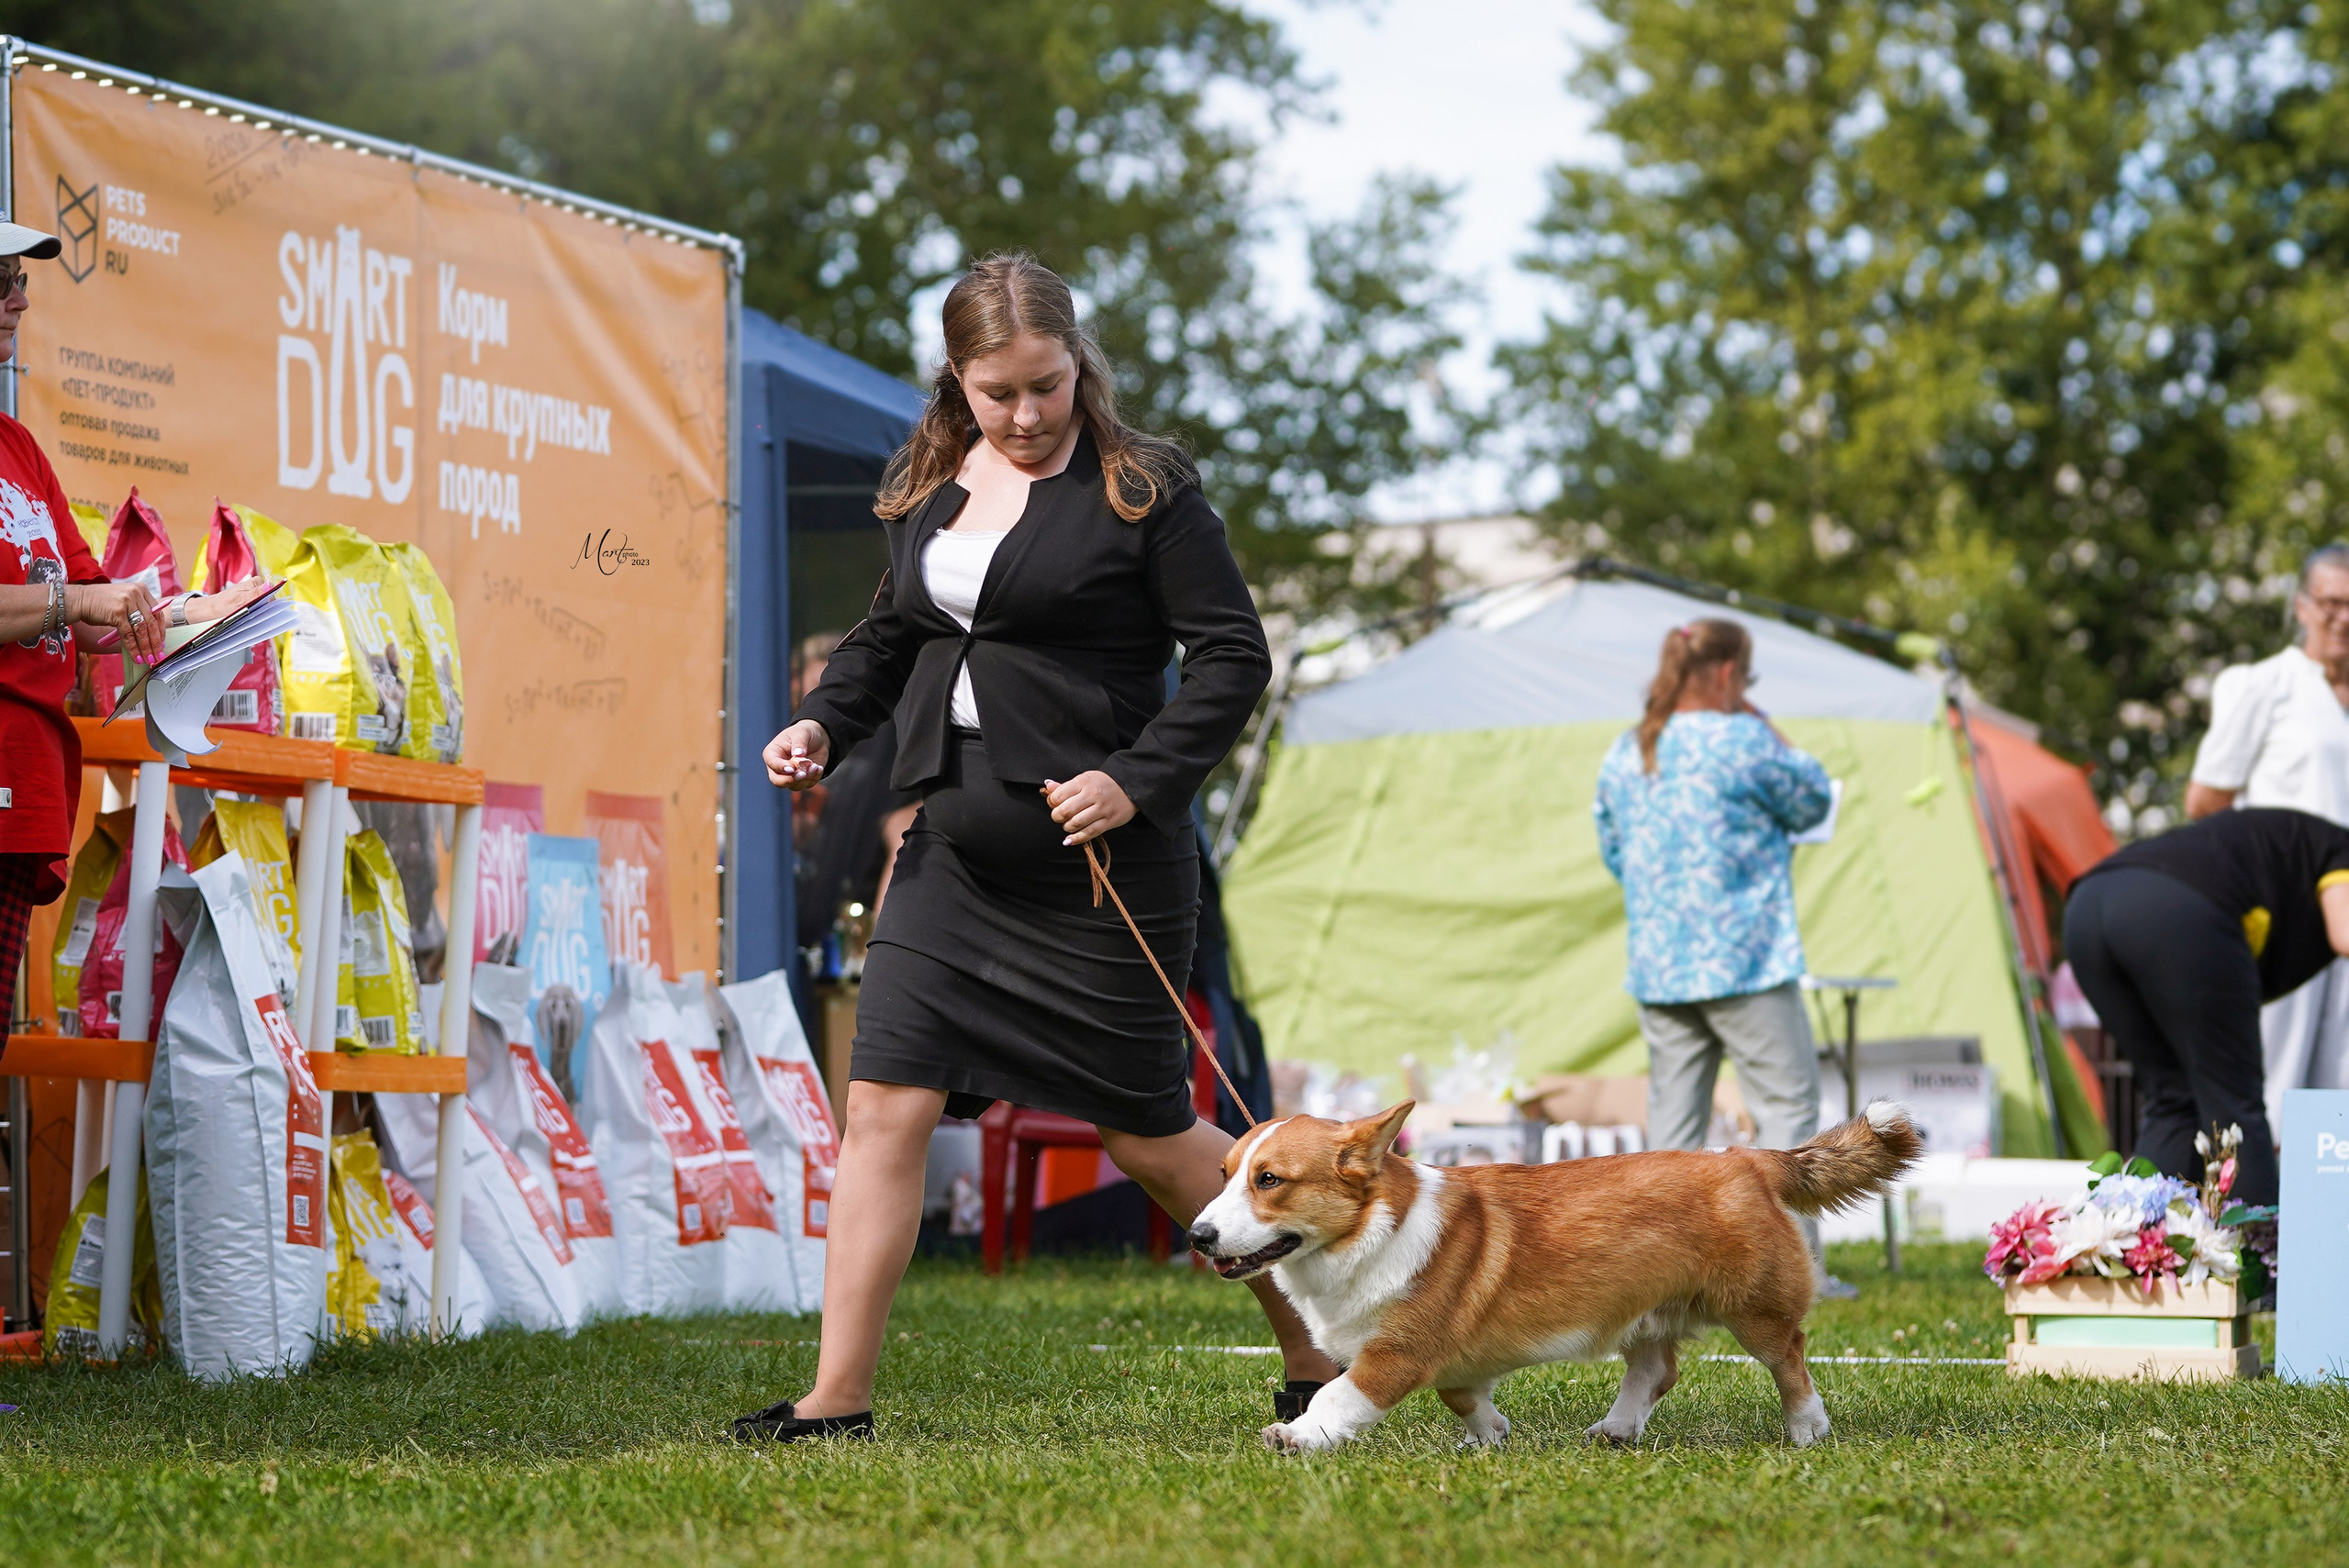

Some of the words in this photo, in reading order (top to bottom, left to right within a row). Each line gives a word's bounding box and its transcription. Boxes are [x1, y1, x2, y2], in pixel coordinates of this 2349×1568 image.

[106, 184, 146, 217] PETS
[106, 217, 181, 256] PRODUCT
[106, 250, 128, 275] RU
[278, 223, 412, 349] SMART
[438, 261, 509, 365] Корм
[59, 345, 106, 373] ГРУППА
[107, 354, 175, 387] КОМПАНИЙ
[60, 411, 108, 431] оптовая
[111, 418, 161, 442] продажа
[438, 373, 489, 436] для
[492, 384, 611, 462] крупных
[59, 440, 107, 463] товаров
[108, 448, 131, 466] для
[132, 453, 189, 475] животных
[439, 461, 520, 540] пород
